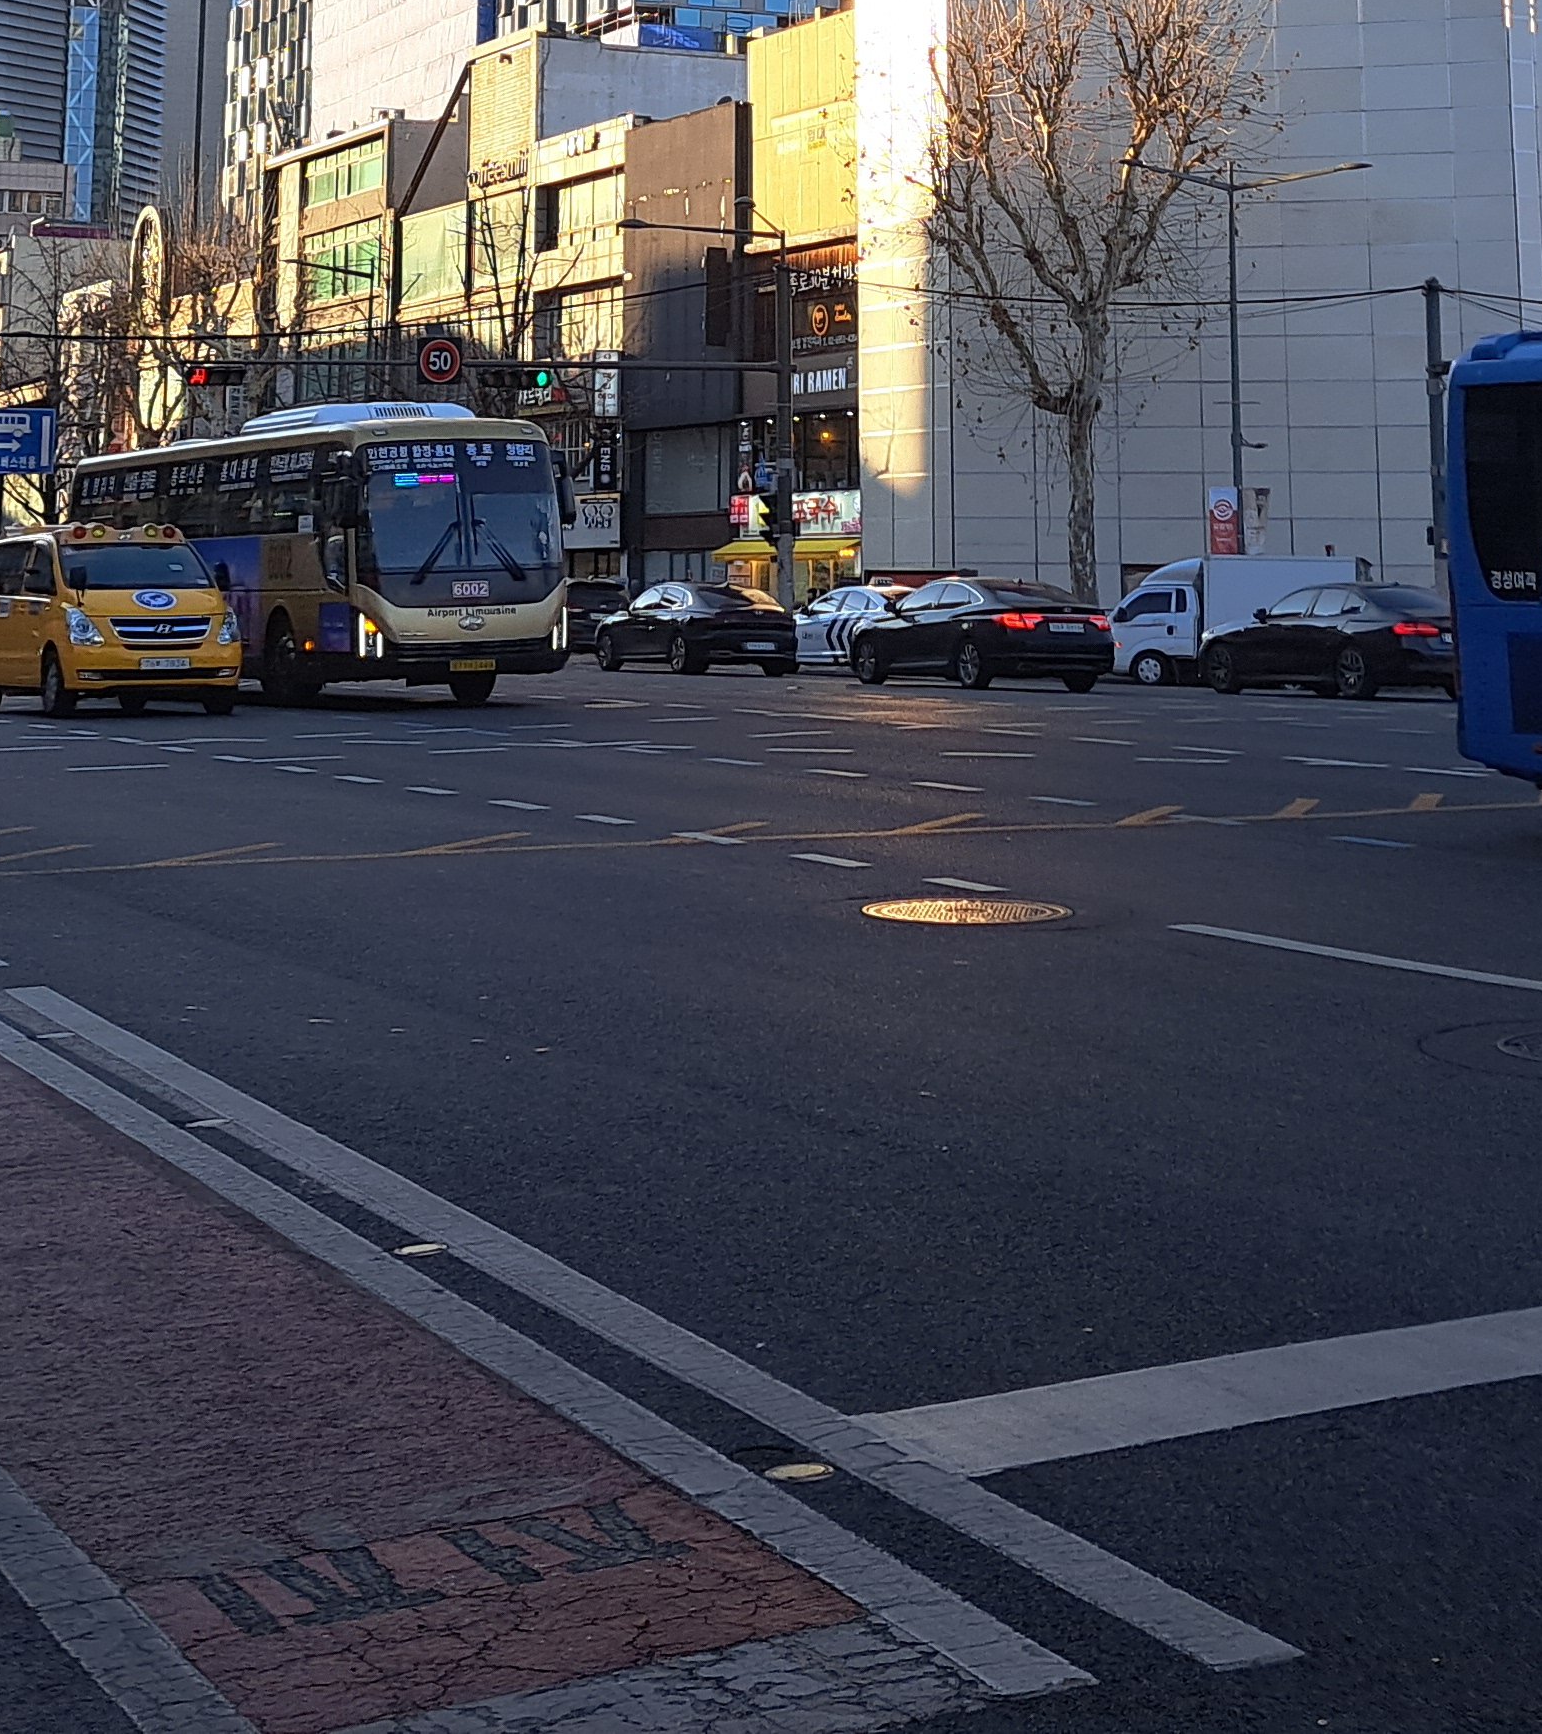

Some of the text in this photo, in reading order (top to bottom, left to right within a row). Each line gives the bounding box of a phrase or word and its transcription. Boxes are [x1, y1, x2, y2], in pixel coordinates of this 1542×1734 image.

[428, 351, 451, 371] 50
[808, 367, 848, 393] RAMEN
[454, 582, 488, 596] 6002
[1491, 570, 1537, 591] 경성여객
[427, 605, 517, 619] Airport Limousine
